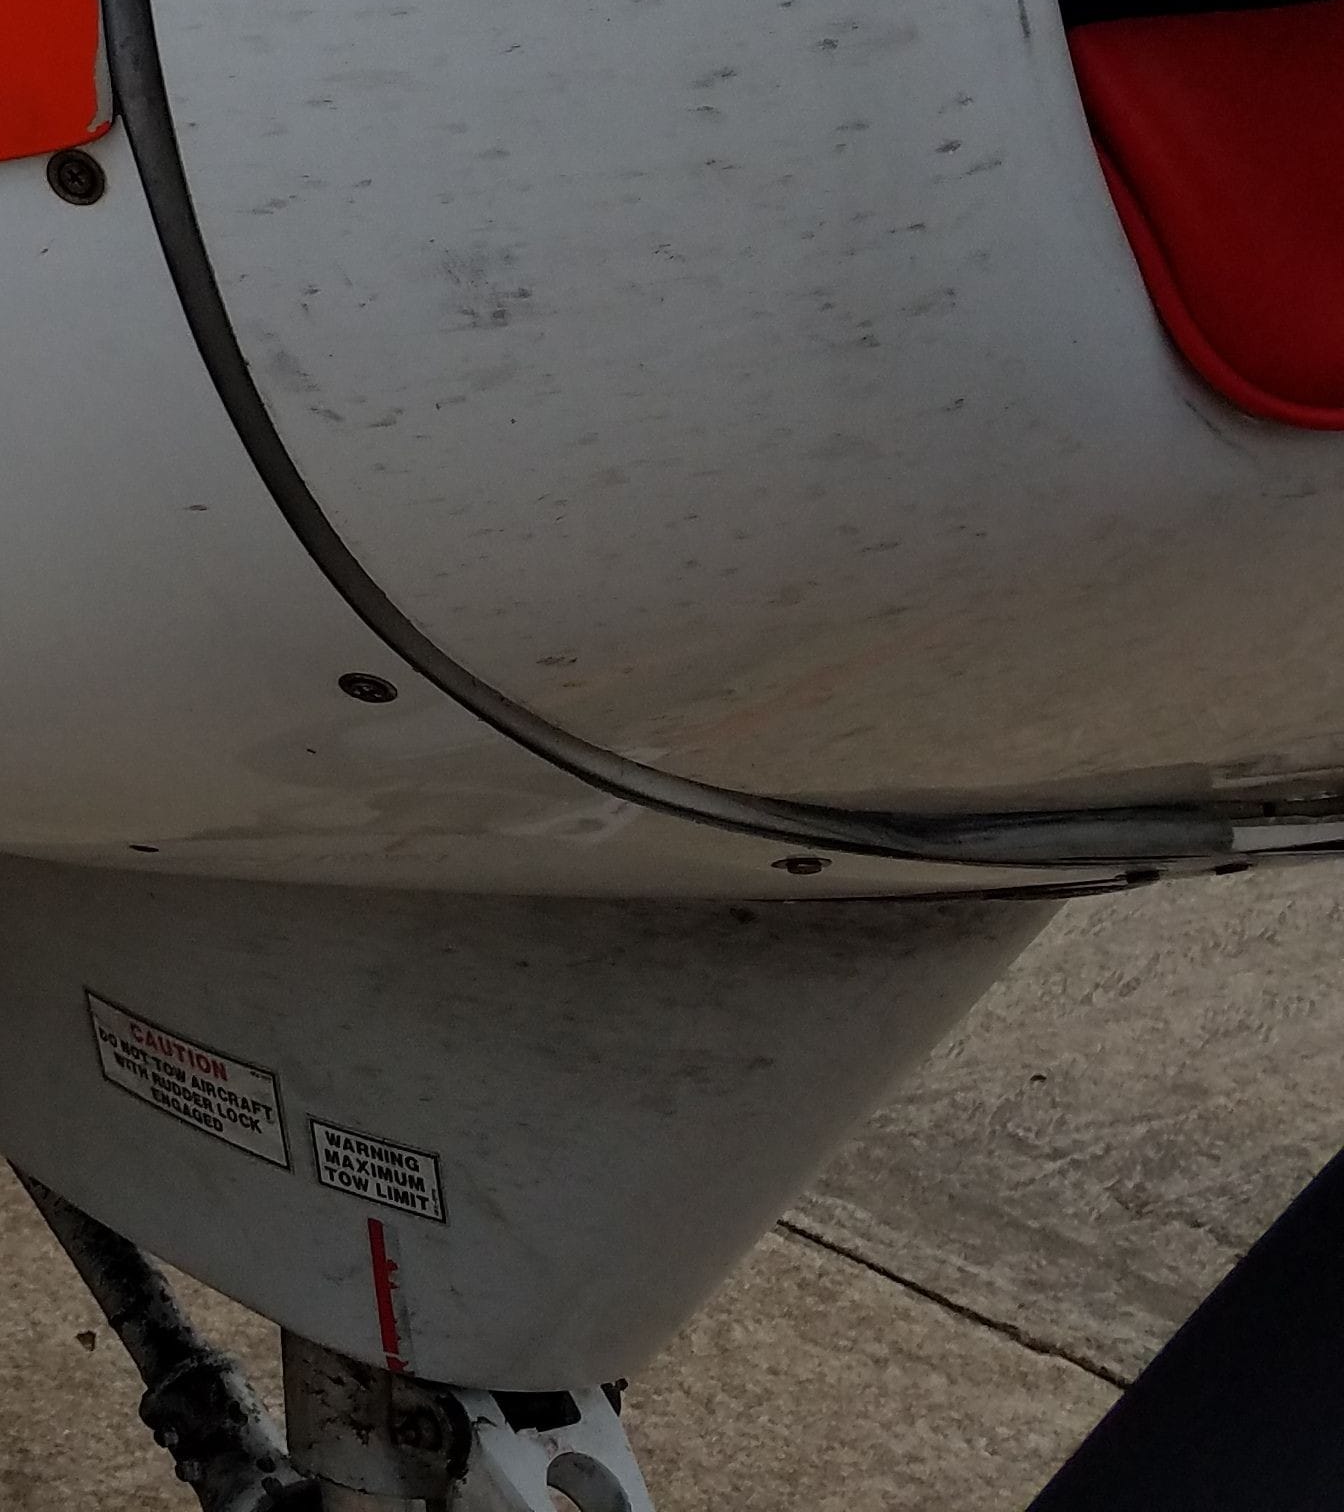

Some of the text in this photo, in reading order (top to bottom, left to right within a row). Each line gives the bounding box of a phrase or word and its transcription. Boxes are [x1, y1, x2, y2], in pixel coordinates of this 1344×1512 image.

[98, 1027, 118, 1048] DO
[120, 1039, 148, 1060] NOT
[152, 1057, 186, 1083] TOW
[191, 1075, 273, 1121] AIRCRAFT
[128, 1022, 228, 1081] CAUTION
[114, 1051, 149, 1080] WITH
[151, 1072, 213, 1113] RUDDER
[217, 1102, 262, 1134] LOCK
[150, 1086, 224, 1132] ENGAGED
[324, 1148, 426, 1193] MAXIMUM
[325, 1130, 420, 1172] WARNING
[324, 1165, 369, 1193] TOW
[376, 1182, 429, 1211] LIMIT
